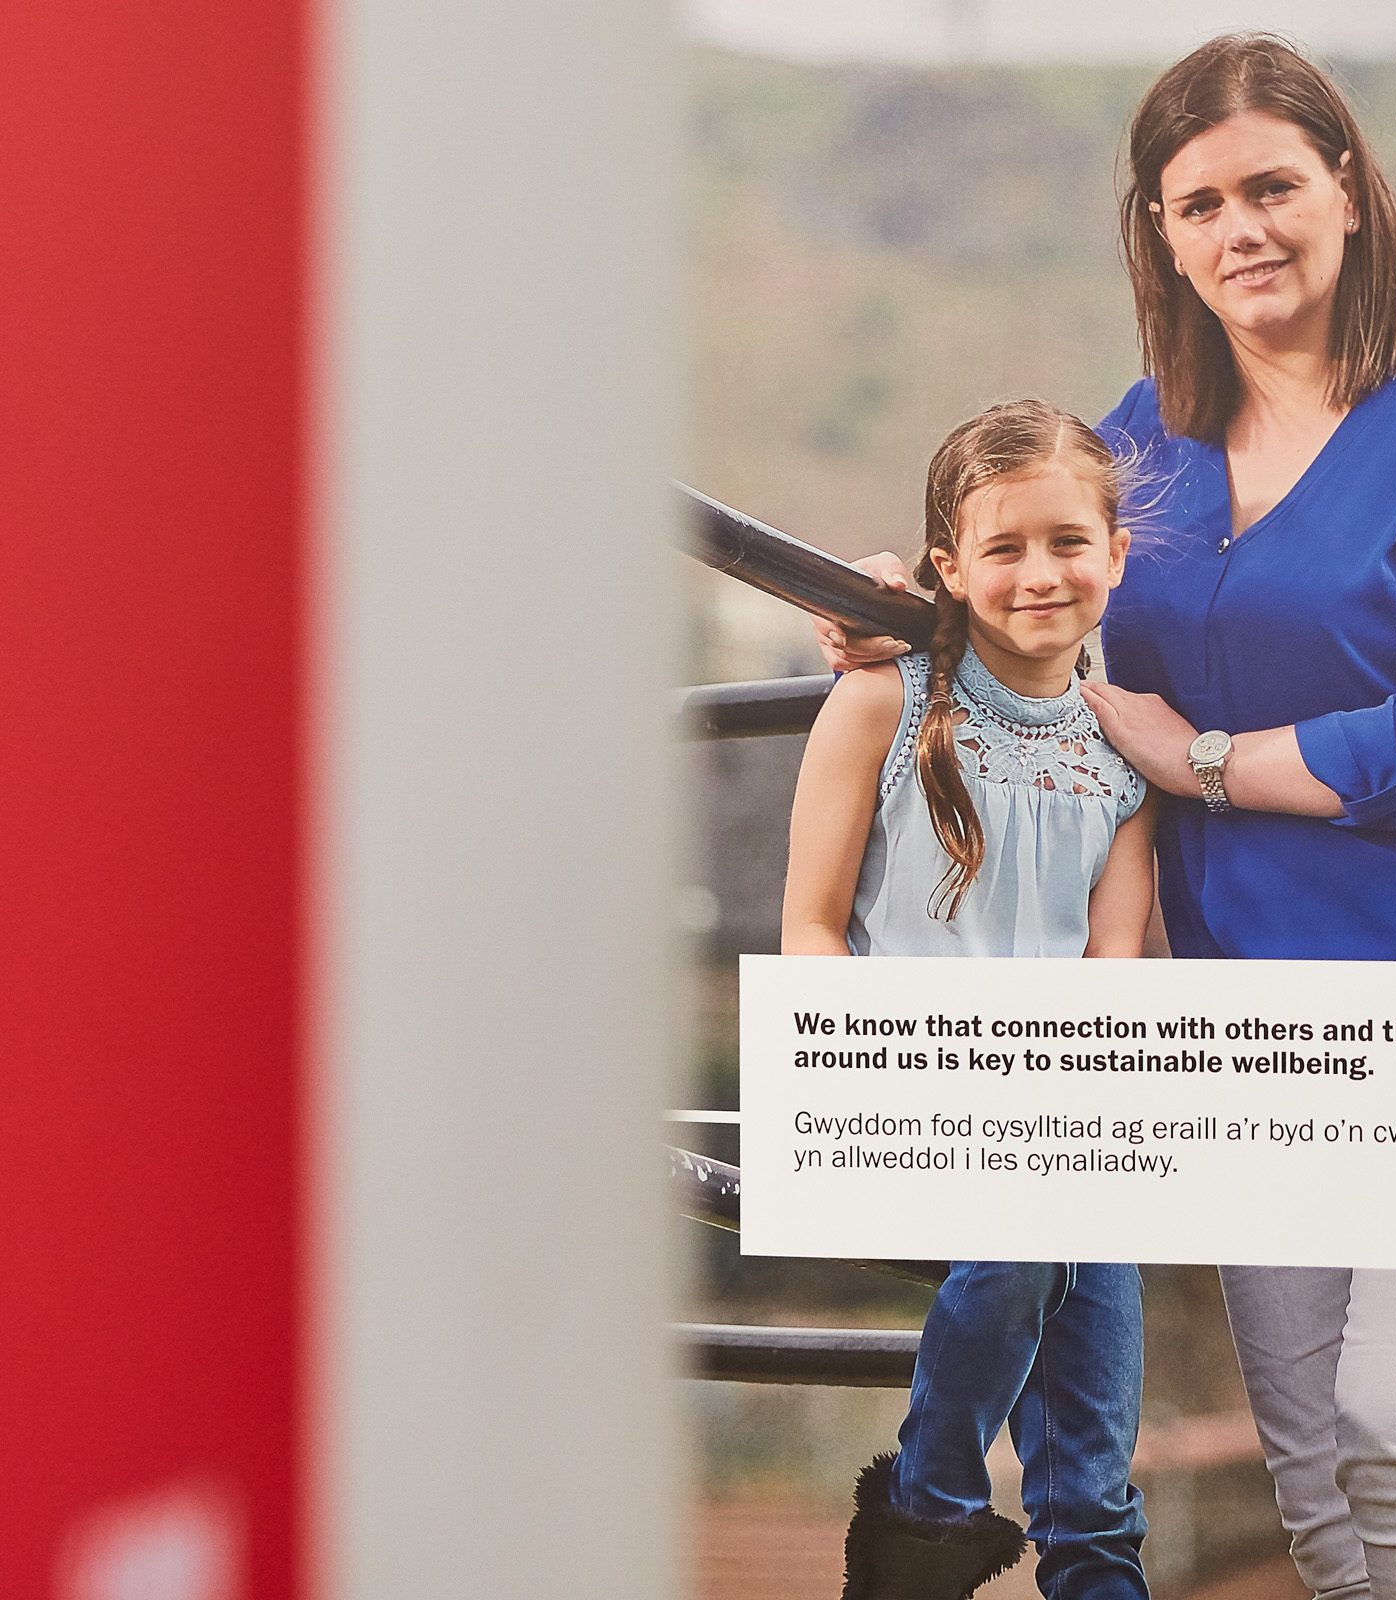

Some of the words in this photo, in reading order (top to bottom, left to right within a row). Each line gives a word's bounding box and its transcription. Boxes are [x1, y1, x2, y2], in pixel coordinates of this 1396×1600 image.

[793, 1012, 836, 1036] We
[845, 1013, 918, 1037] know
[925, 1014, 983, 1038] that
[991, 1015, 1147, 1039] connection
[1156, 1016, 1215, 1040] with
[1225, 1017, 1314, 1041] others
[1322, 1019, 1373, 1042] and
[794, 1046, 887, 1070] around
[897, 1052, 928, 1070] us
[937, 1047, 960, 1071] is
[969, 1047, 1016, 1076] key
[1023, 1049, 1051, 1071] to
[1059, 1049, 1223, 1073] sustainable
[1231, 1051, 1374, 1081] wellbeing.
[794, 1111, 921, 1140] Gwyddom
[930, 1113, 972, 1137] fod
[982, 1114, 1101, 1143] cysylltiad
[1112, 1119, 1145, 1145] ag
[1152, 1117, 1216, 1140] eraill
[1226, 1117, 1260, 1141] a’r
[1270, 1118, 1314, 1147] byd
[1324, 1119, 1363, 1142] o’n
[794, 1149, 822, 1172] yn
[831, 1145, 954, 1170] allweddol
[965, 1146, 972, 1171] i
[981, 1147, 1018, 1171] les
[1027, 1148, 1178, 1178] cynaliadwy.
